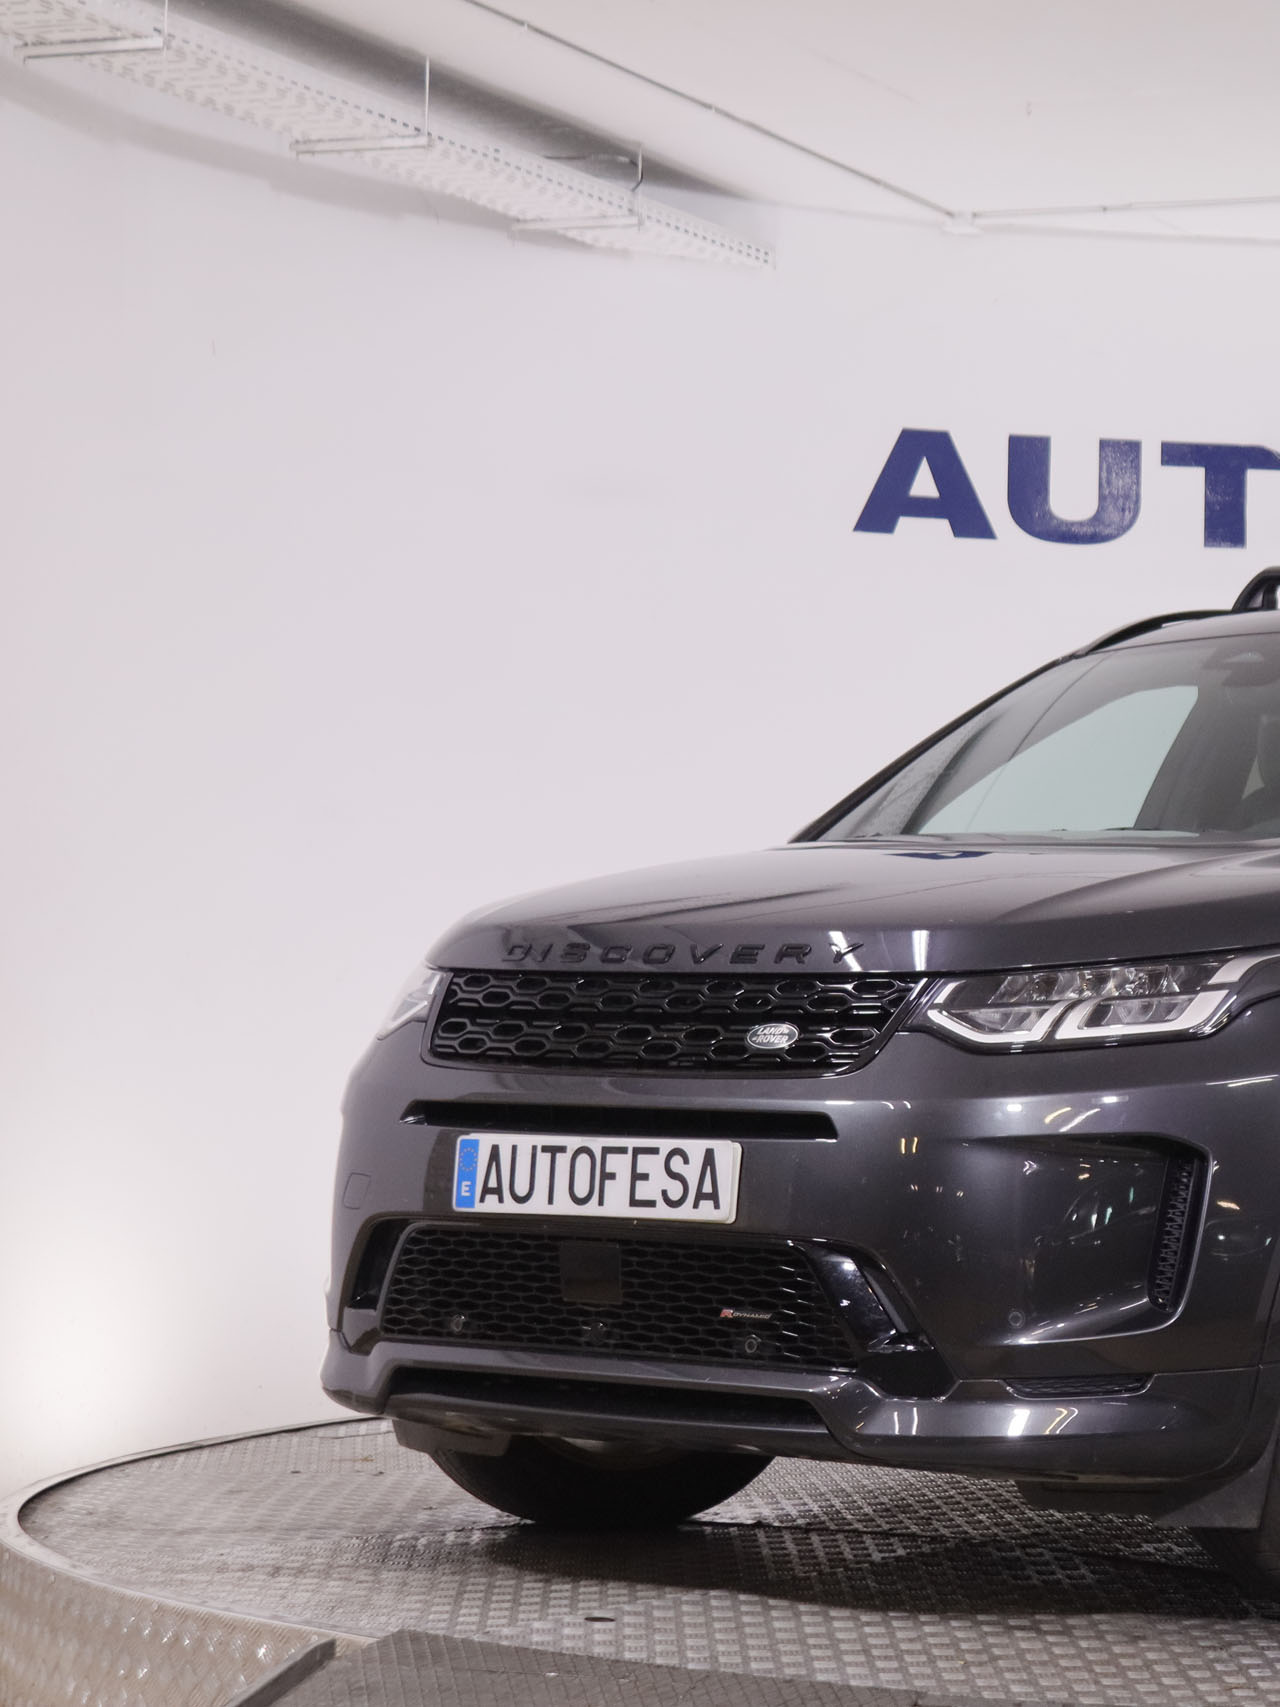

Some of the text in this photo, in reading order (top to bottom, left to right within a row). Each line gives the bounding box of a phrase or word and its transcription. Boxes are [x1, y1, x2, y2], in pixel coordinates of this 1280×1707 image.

[502, 943, 864, 964] DISCOVERY
[757, 1027, 785, 1035] LAND
[756, 1034, 789, 1044] ROVER
[461, 1144, 720, 1210] E AUTOFESA
